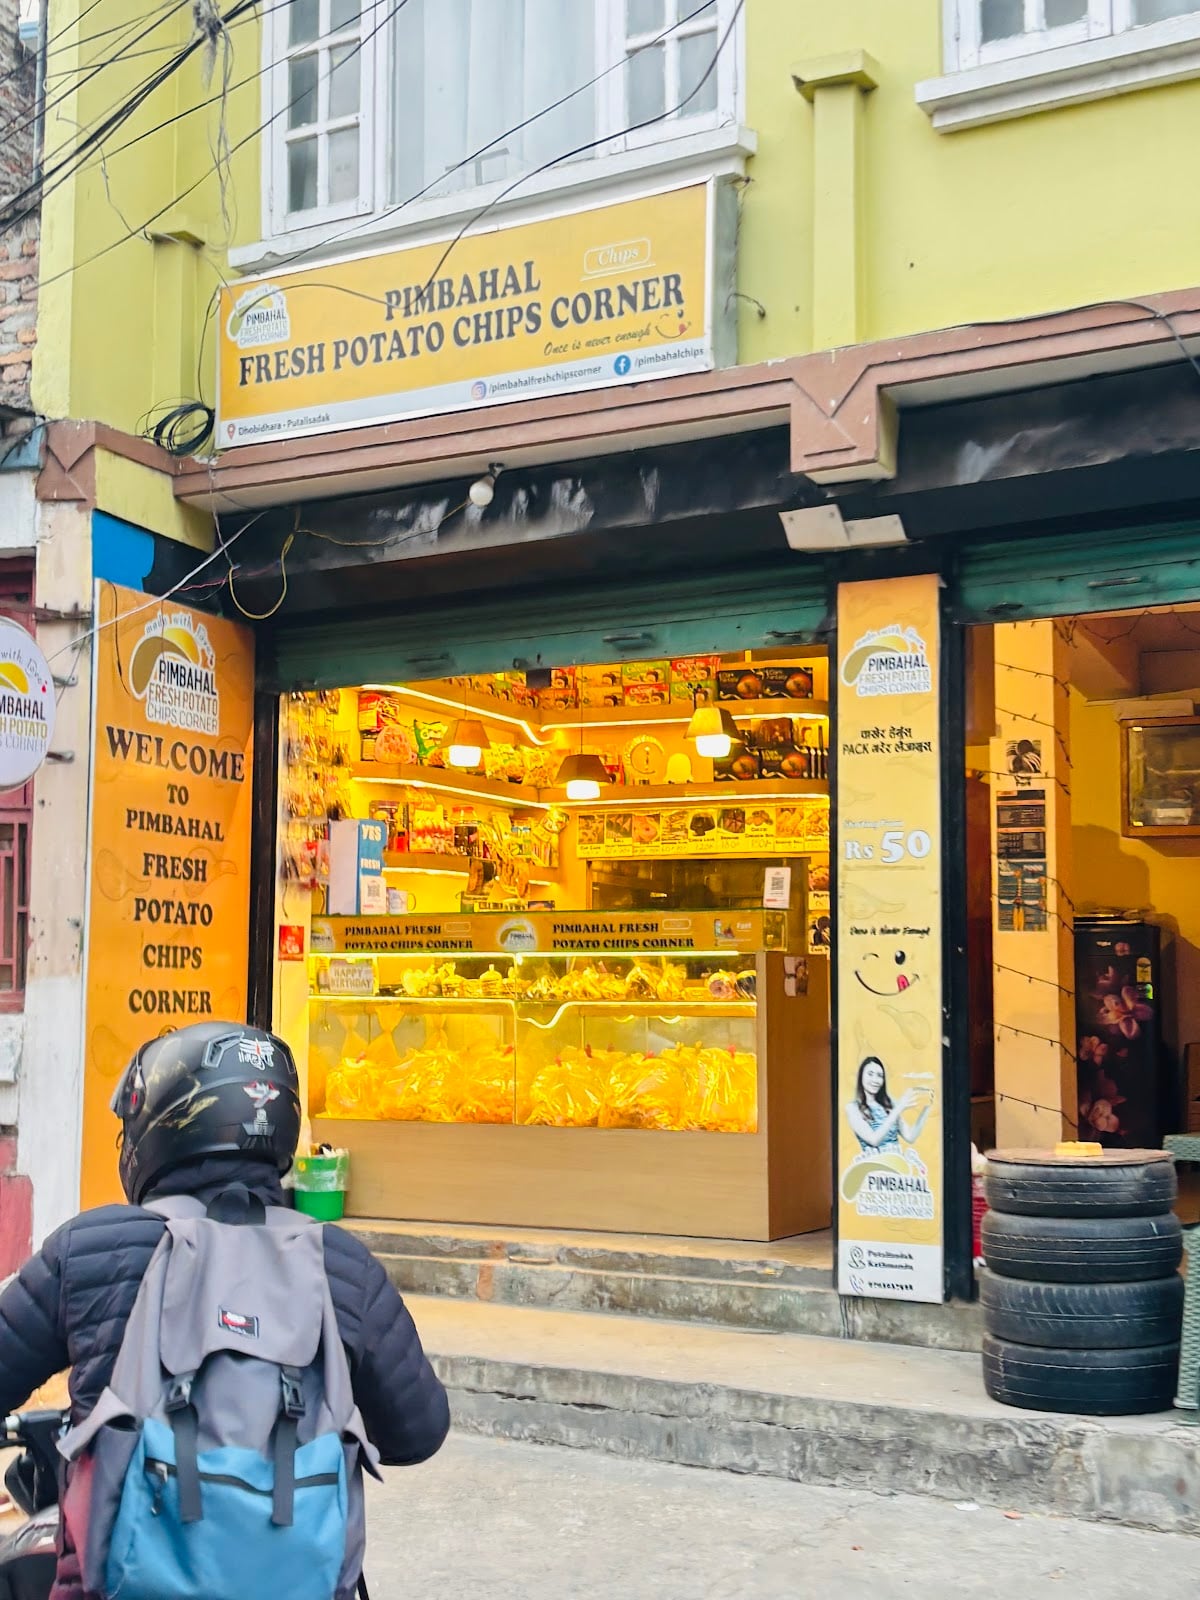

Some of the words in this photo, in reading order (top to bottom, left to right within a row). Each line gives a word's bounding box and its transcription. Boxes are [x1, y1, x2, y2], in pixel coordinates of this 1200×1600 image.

[598, 247, 639, 266] Chips
[385, 261, 541, 321] PIMBAHAL
[246, 309, 287, 326] PIMBAHAL
[239, 342, 326, 386] FRESH
[333, 321, 445, 370] POTATO
[453, 302, 542, 346] CHIPS
[550, 273, 684, 328] CORNER
[543, 341, 568, 356] Once
[572, 339, 581, 350] is
[585, 337, 611, 349] never
[615, 323, 651, 343] enough
[634, 346, 704, 368] /pimbahalchips
[488, 365, 602, 393] /pimbahalfreshchipscorner
[1, 649, 22, 661] with
[868, 655, 928, 671] PIMBAHAL
[159, 659, 217, 696] PIMBAHAL
[892, 669, 930, 680] POTATO
[0, 695, 46, 720] MBAHAL
[149, 683, 181, 705] FRESH
[183, 690, 218, 716] POTATO
[10, 718, 47, 739] POTATO
[147, 703, 177, 723] CHIPS
[179, 710, 218, 733] CORNER
[6, 736, 46, 752] CORNER
[106, 726, 245, 782] WELCOME
[842, 743, 869, 755] PACK
[167, 783, 189, 805] TO
[126, 809, 225, 842] PIMBAHAL
[844, 840, 874, 860] Rs
[880, 830, 931, 863] 50
[142, 853, 208, 882] FRESH
[134, 898, 213, 926] POTATO
[345, 926, 401, 936] PIMBAHAL
[405, 925, 441, 936] FRESH
[553, 923, 616, 933] PIMBAHAL
[619, 923, 659, 933] FRESH
[345, 940, 388, 949] POTATO
[391, 940, 424, 949] CHIPS
[426, 939, 473, 949] CORNER
[553, 938, 600, 948] POTATO
[602, 938, 640, 948] CHIPS
[642, 938, 695, 948] CORNER
[143, 943, 203, 969] CHIPS
[128, 989, 213, 1014] CORNER
[868, 1175, 930, 1193] PIMBAHAL
